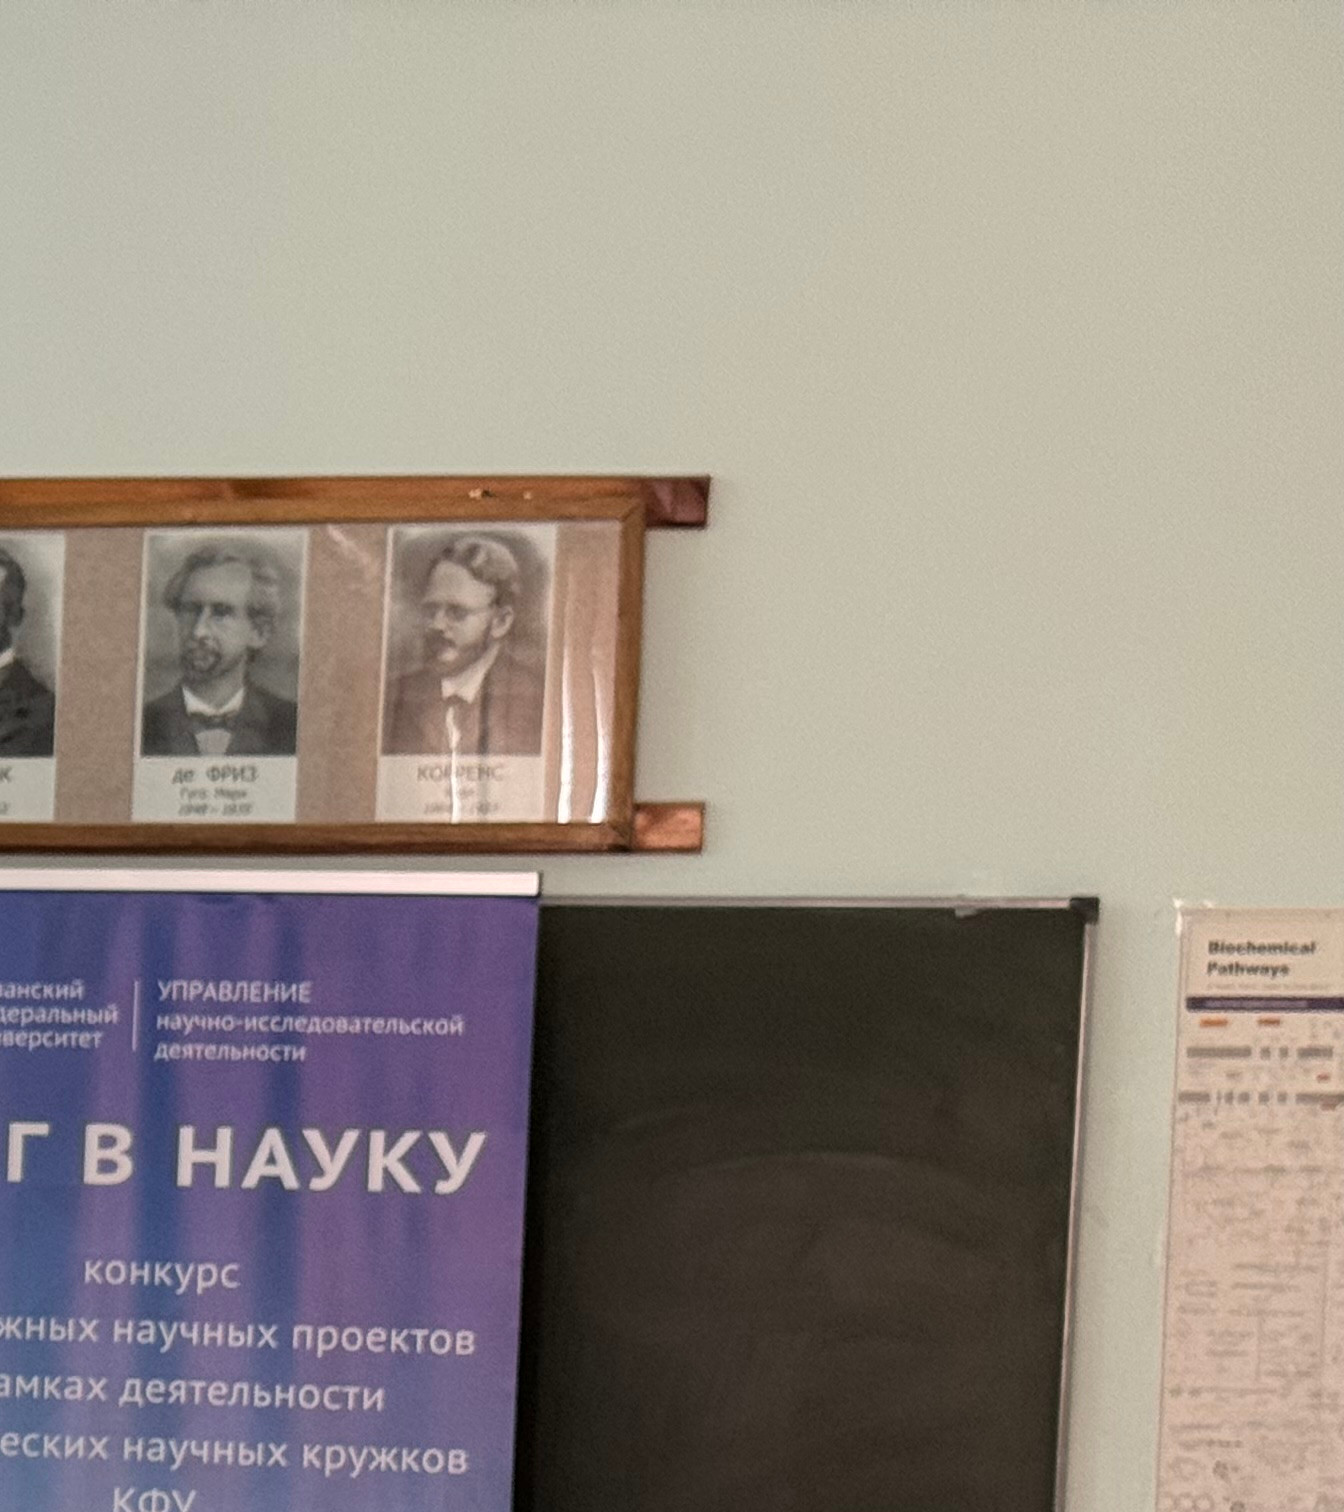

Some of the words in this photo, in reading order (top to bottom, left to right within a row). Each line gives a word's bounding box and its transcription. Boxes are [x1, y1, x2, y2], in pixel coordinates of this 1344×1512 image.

[206, 765, 259, 783] ФРИЗ
[1207, 939, 1316, 955] Biochemical
[1207, 961, 1290, 979] Pathways
[158, 978, 312, 1003] УПРАВЛЕНИЕ
[156, 1013, 464, 1036] научно-исследовательской
[153, 1041, 306, 1062] деятельности
[82, 1123, 135, 1186] В
[176, 1125, 486, 1195] НАУКУ
[83, 1258, 241, 1295] конкурс
[112, 1315, 278, 1354] научных
[291, 1323, 478, 1358] проектов
[118, 1378, 386, 1412] деятельности
[122, 1434, 289, 1472] научных
[302, 1441, 469, 1479] кружков
